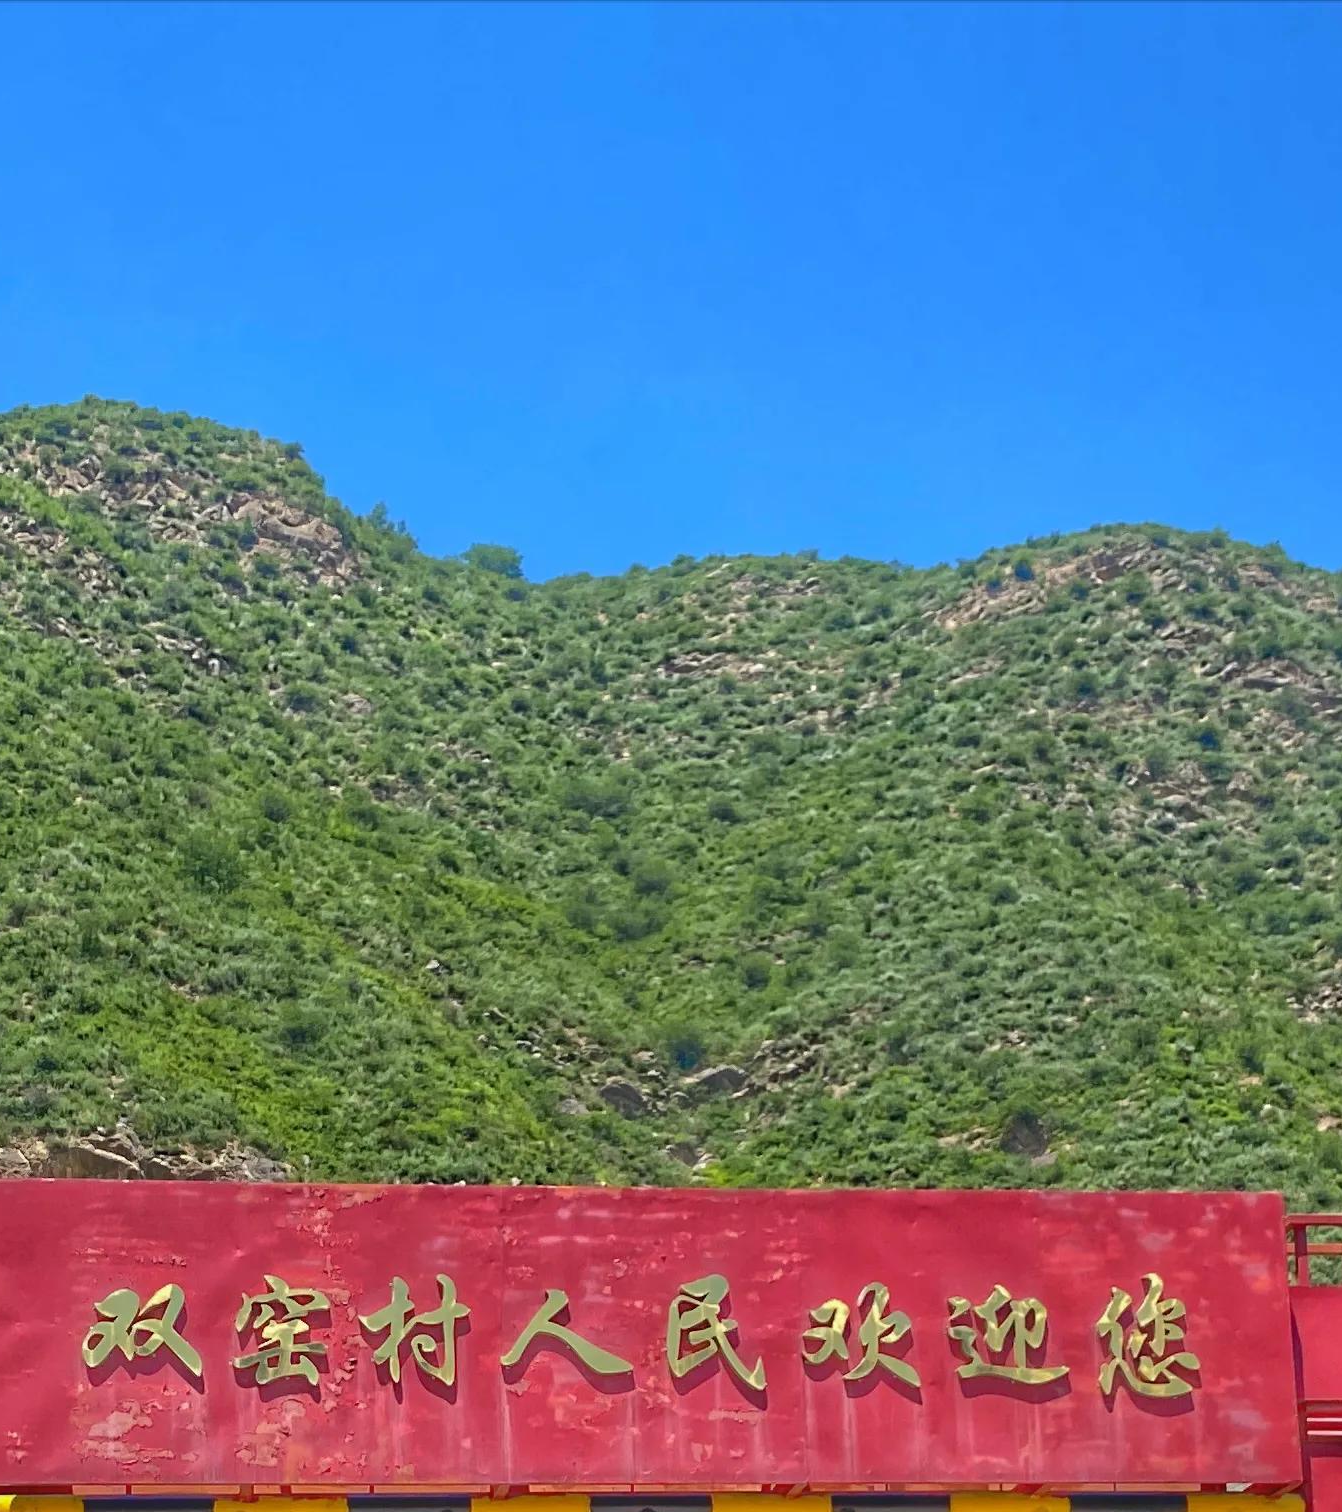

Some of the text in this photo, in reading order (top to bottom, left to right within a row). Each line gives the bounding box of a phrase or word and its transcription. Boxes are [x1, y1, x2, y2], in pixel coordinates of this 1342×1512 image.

[82, 1273, 1200, 1399] 双窑村人民欢迎您
